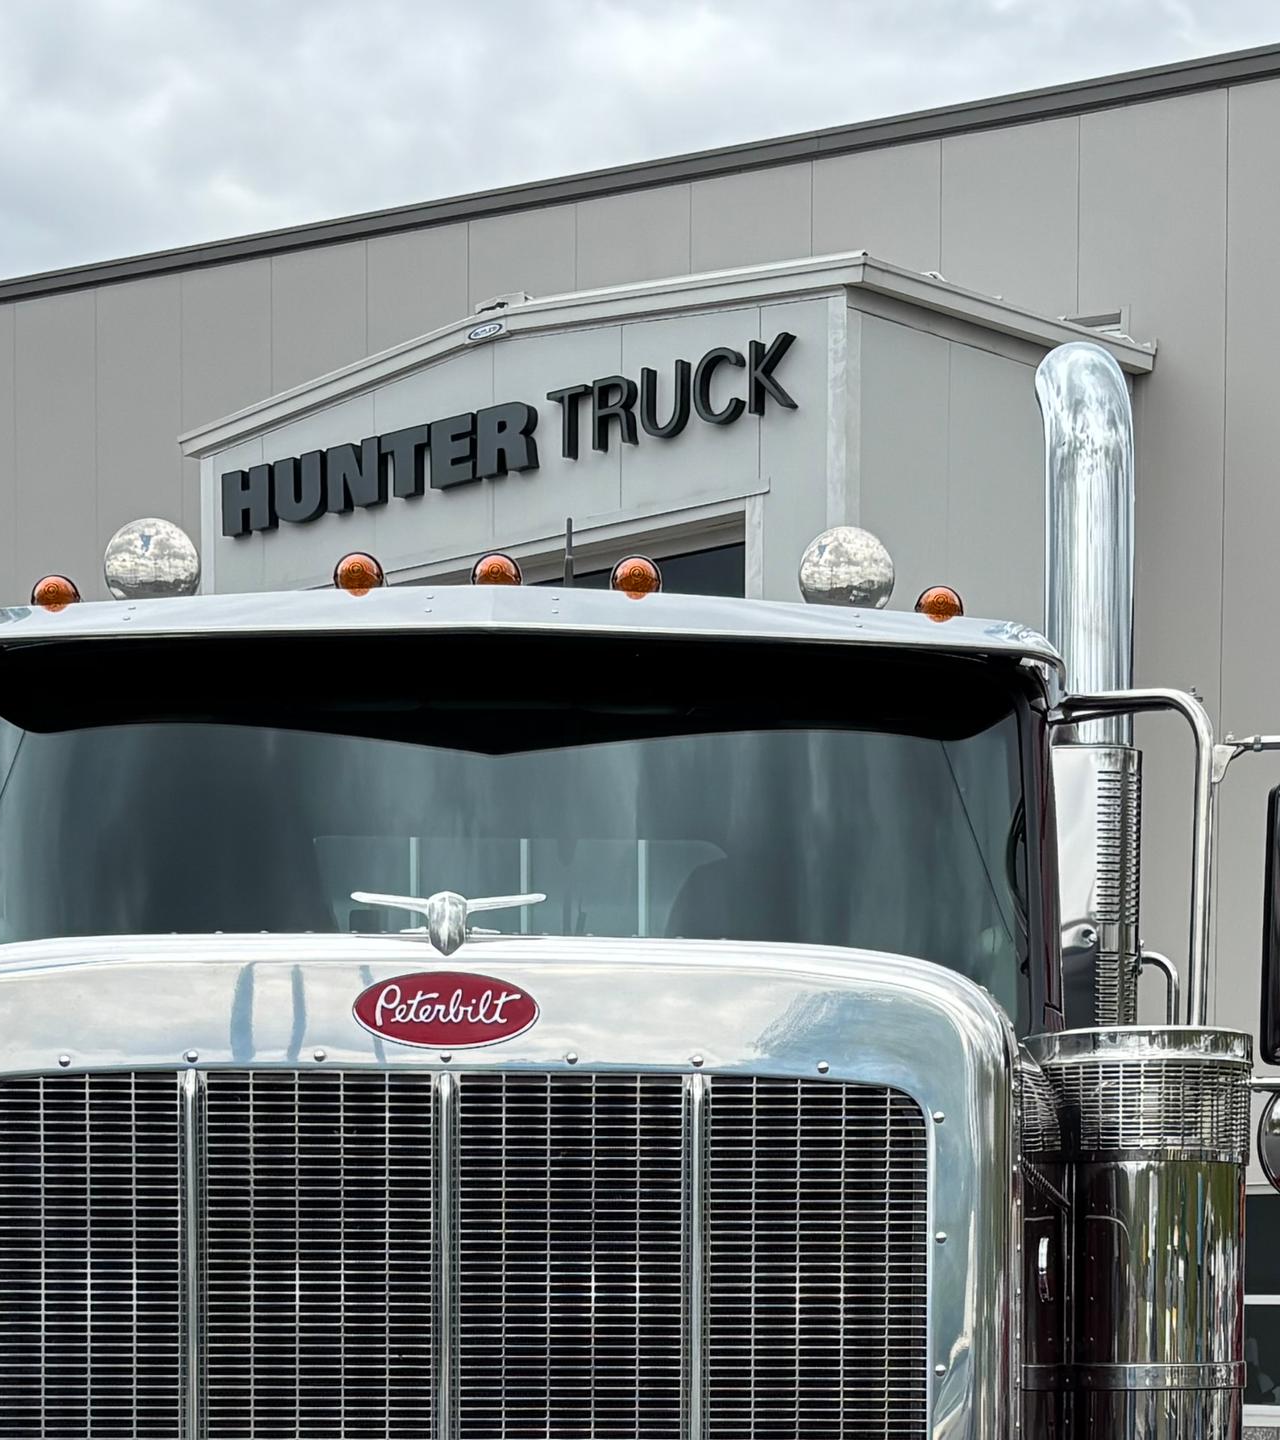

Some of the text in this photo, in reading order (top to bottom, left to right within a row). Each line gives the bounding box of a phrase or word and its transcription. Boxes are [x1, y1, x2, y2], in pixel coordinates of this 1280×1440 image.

[222, 331, 797, 538] HUNTER TRUCK
[375, 985, 522, 1027] Peterbilt
